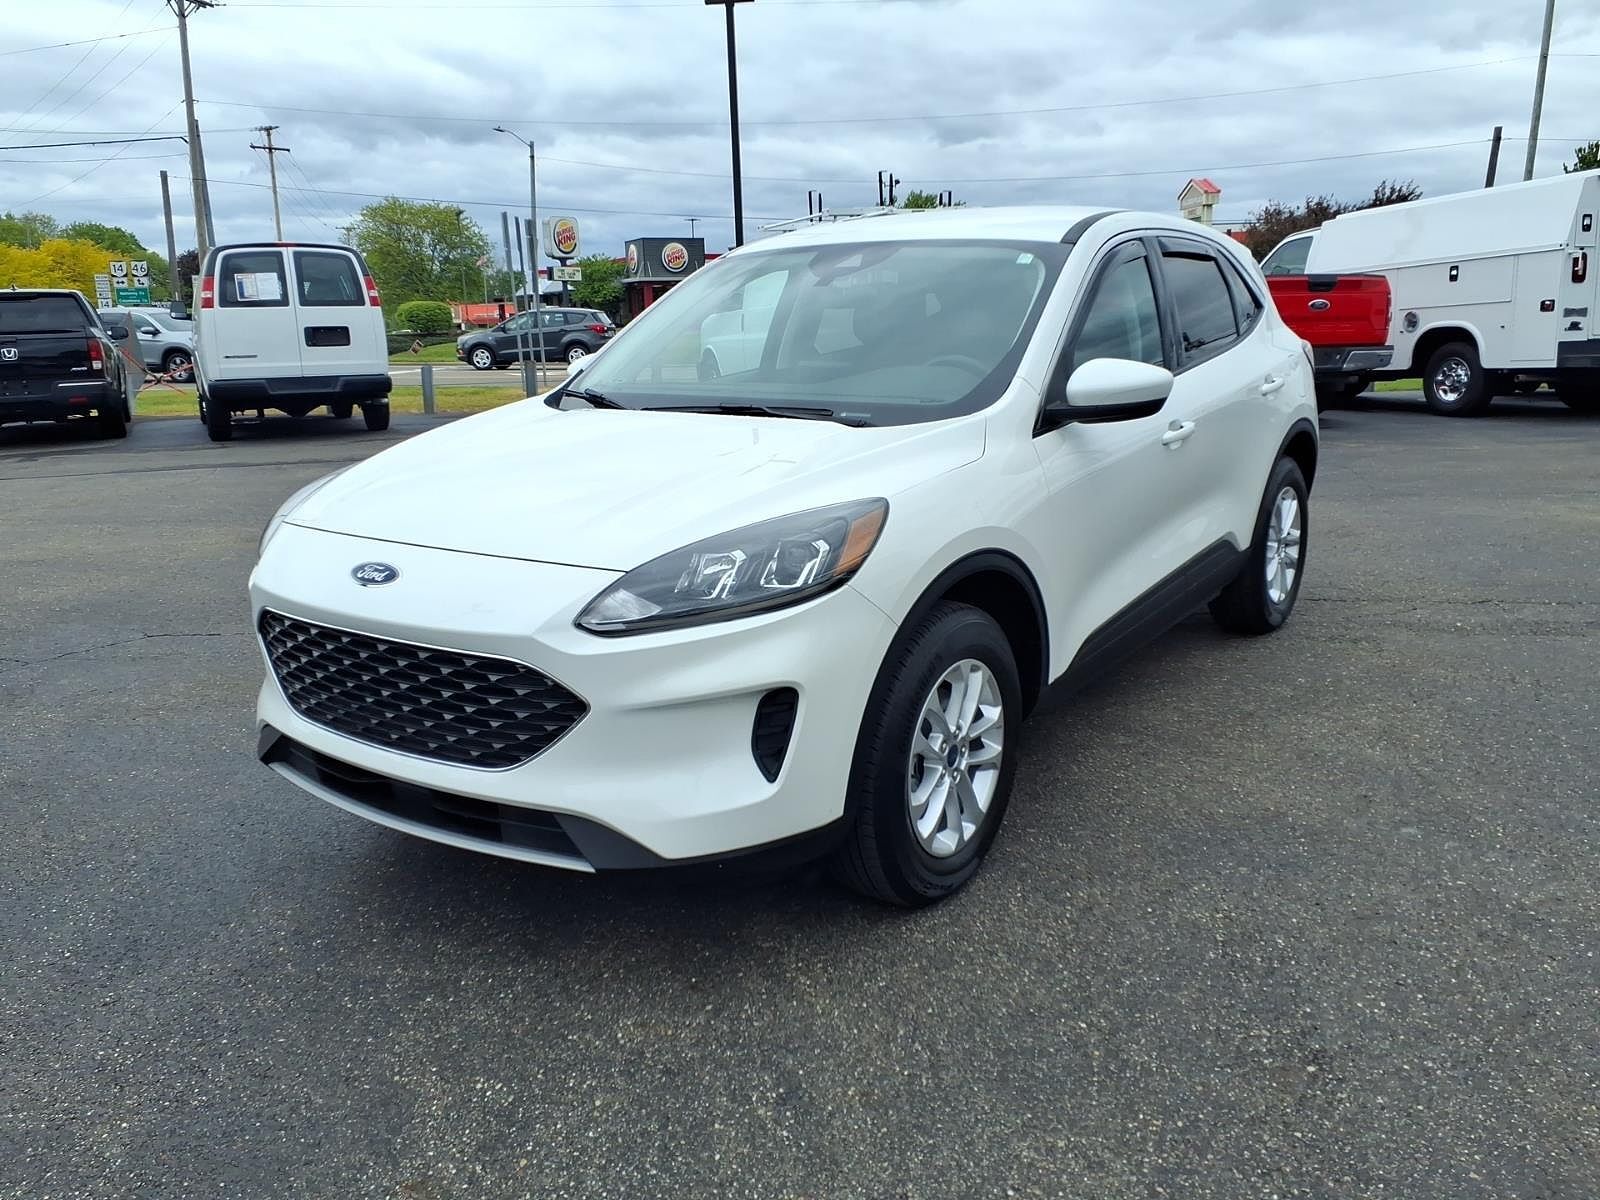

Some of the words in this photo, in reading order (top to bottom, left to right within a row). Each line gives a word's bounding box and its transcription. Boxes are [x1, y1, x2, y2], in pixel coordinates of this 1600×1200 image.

[557, 226, 574, 238] BURGER
[558, 232, 576, 247] KING
[668, 253, 685, 264] KING
[112, 264, 123, 273] 14
[132, 263, 146, 273] 46
[357, 564, 390, 581] Ford
